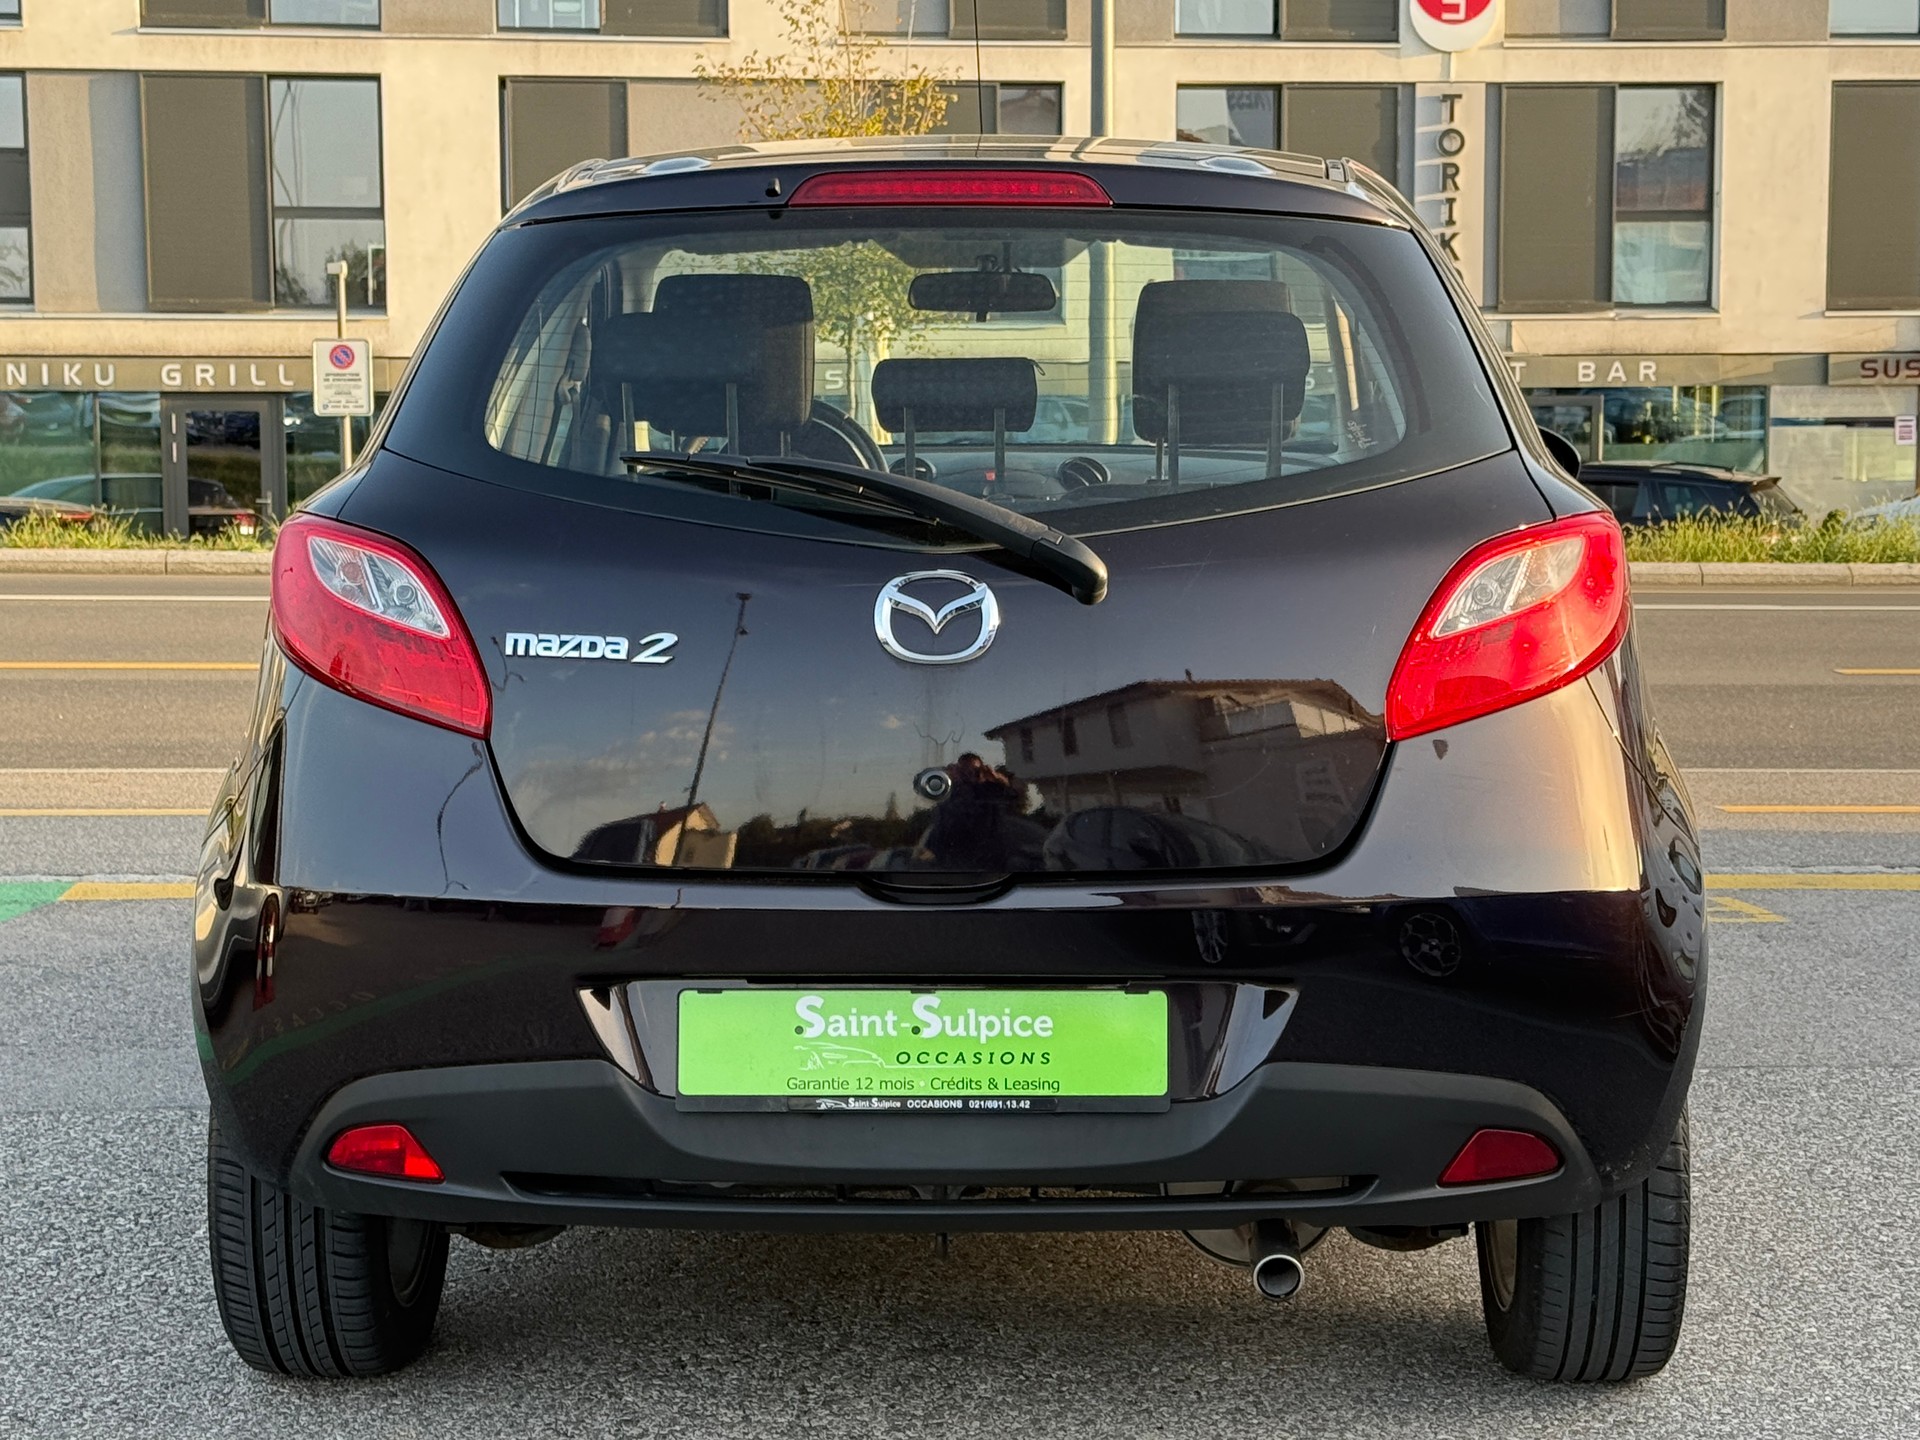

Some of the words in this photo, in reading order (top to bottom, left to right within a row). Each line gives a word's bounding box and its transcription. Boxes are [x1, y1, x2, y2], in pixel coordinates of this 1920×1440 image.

[1437, 94, 1465, 281] TORIK
[6, 363, 115, 386] NIKU
[161, 363, 294, 387] GRILL
[1577, 360, 1657, 383] BAR
[1860, 359, 1920, 379] SUS
[631, 632, 679, 664] 2
[795, 995, 1054, 1044] Saint-Sulpice
[896, 1051, 1051, 1065] OCCASIONS
[786, 1076, 850, 1091] Garantie
[855, 1077, 874, 1091] 12
[879, 1076, 915, 1091] mois
[930, 1076, 982, 1091] Crédits
[987, 1077, 999, 1091] &
[1004, 1077, 1060, 1094] Leasing
[906, 1099, 963, 1109] OCCASIONS
